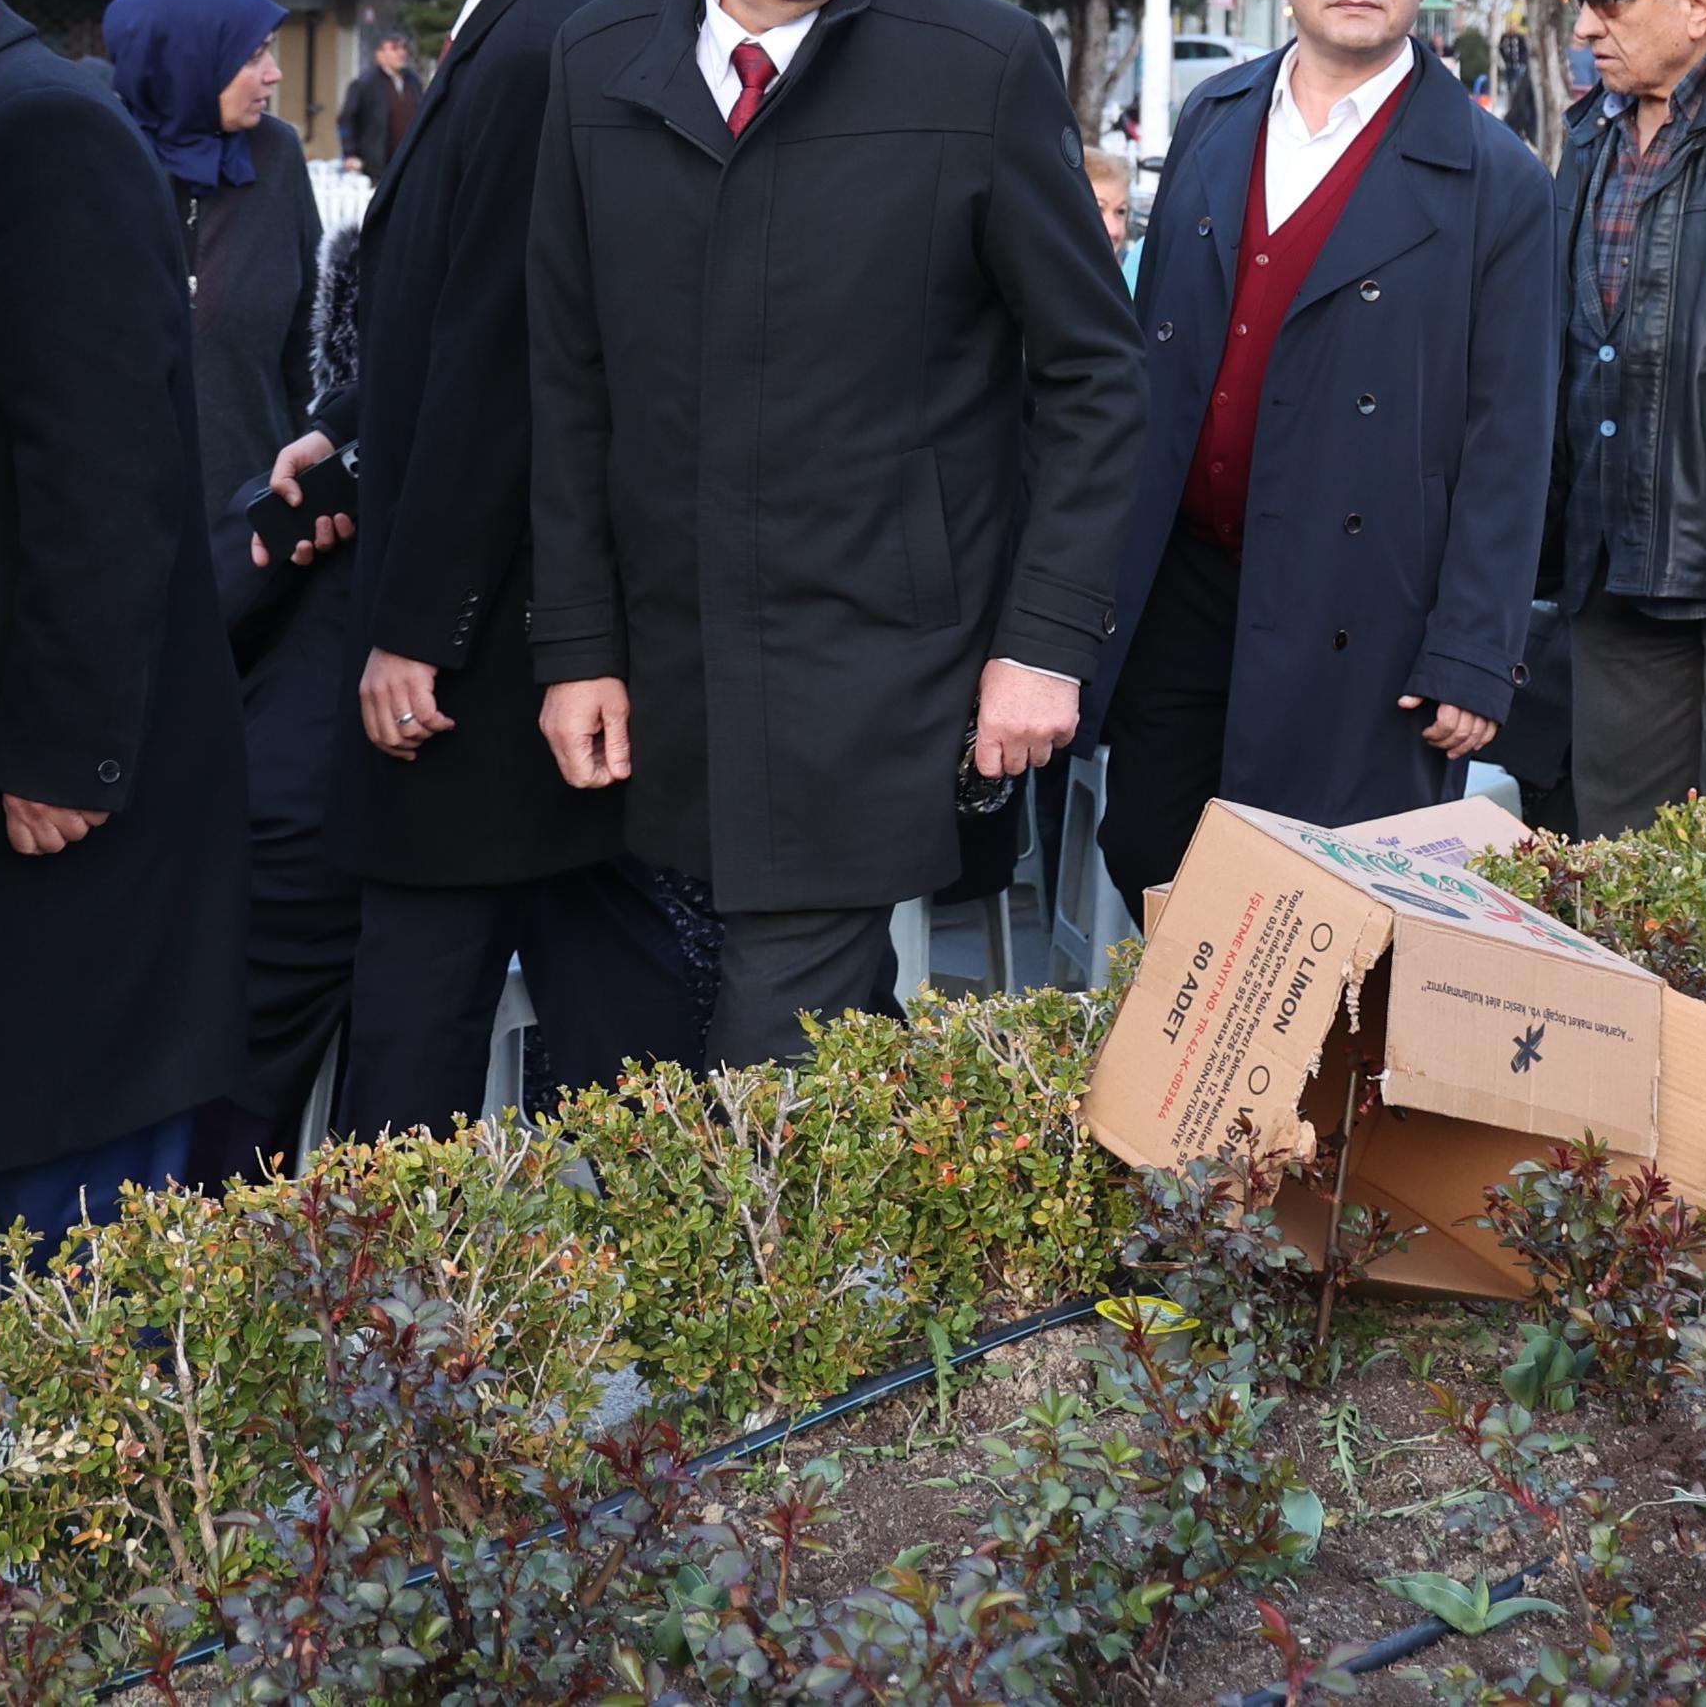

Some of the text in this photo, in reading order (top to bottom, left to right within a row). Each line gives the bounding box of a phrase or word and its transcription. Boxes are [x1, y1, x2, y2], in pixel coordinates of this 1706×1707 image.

[1272, 893, 1287, 914] Tel:
[1279, 888, 1303, 927] Toptan
[1230, 891, 1264, 950] İŞLETME
[1259, 916, 1277, 944] 0332
[1248, 945, 1264, 968] 342
[1258, 929, 1284, 979] Gıdacılar
[1214, 949, 1237, 989] KAYIT
[1241, 969, 1253, 984] 52
[1161, 939, 1215, 1045] 60 ADET
[1203, 989, 1220, 1014] NO:
[1234, 985, 1246, 1001] 95
[1242, 980, 1262, 1014] Sitesi
[1272, 956, 1317, 1035] LİMON
[1485, 995, 1501, 1007] alet
[1503, 1000, 1526, 1014] kesici
[1542, 1007, 1566, 1024] bıçağı
[1196, 916, 1303, 1151] Adana Çevre Yolu Fevzi Çakmak Mahallesi
[1213, 1002, 1239, 1048] Karatay
[1226, 1016, 1246, 1051] 10526
[1568, 1016, 1592, 1029] maket
[1214, 1052, 1230, 1078] Sok:
[1193, 1100, 1209, 1126] Blok
[1183, 1128, 1197, 1148] No:
[1176, 1151, 1188, 1166] 59
